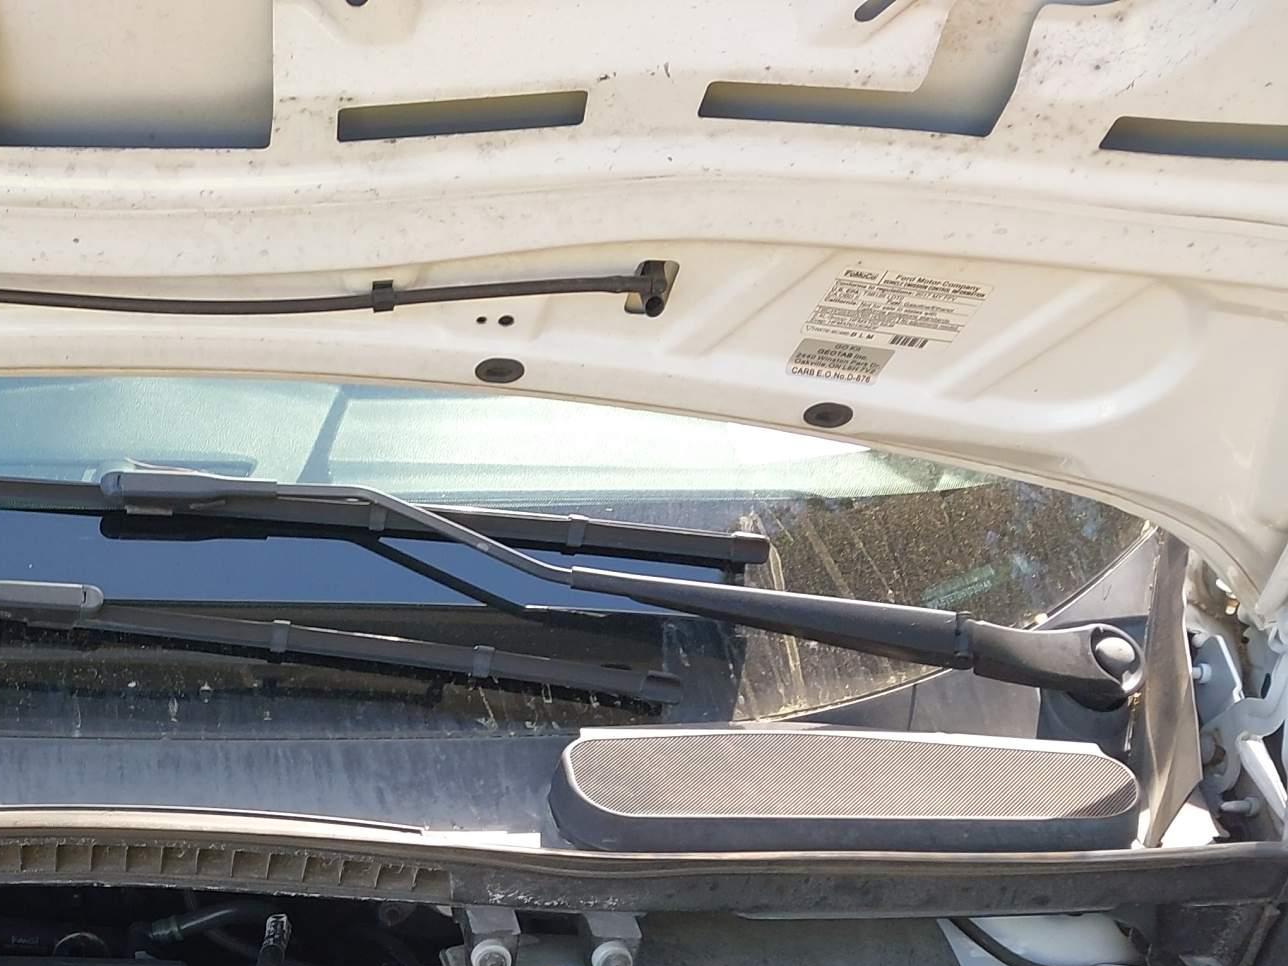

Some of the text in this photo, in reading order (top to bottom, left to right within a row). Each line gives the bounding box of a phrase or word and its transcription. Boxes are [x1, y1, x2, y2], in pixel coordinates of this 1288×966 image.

[896, 274, 981, 292] Ford Motor Company
[817, 348, 853, 358] GEOTAB
